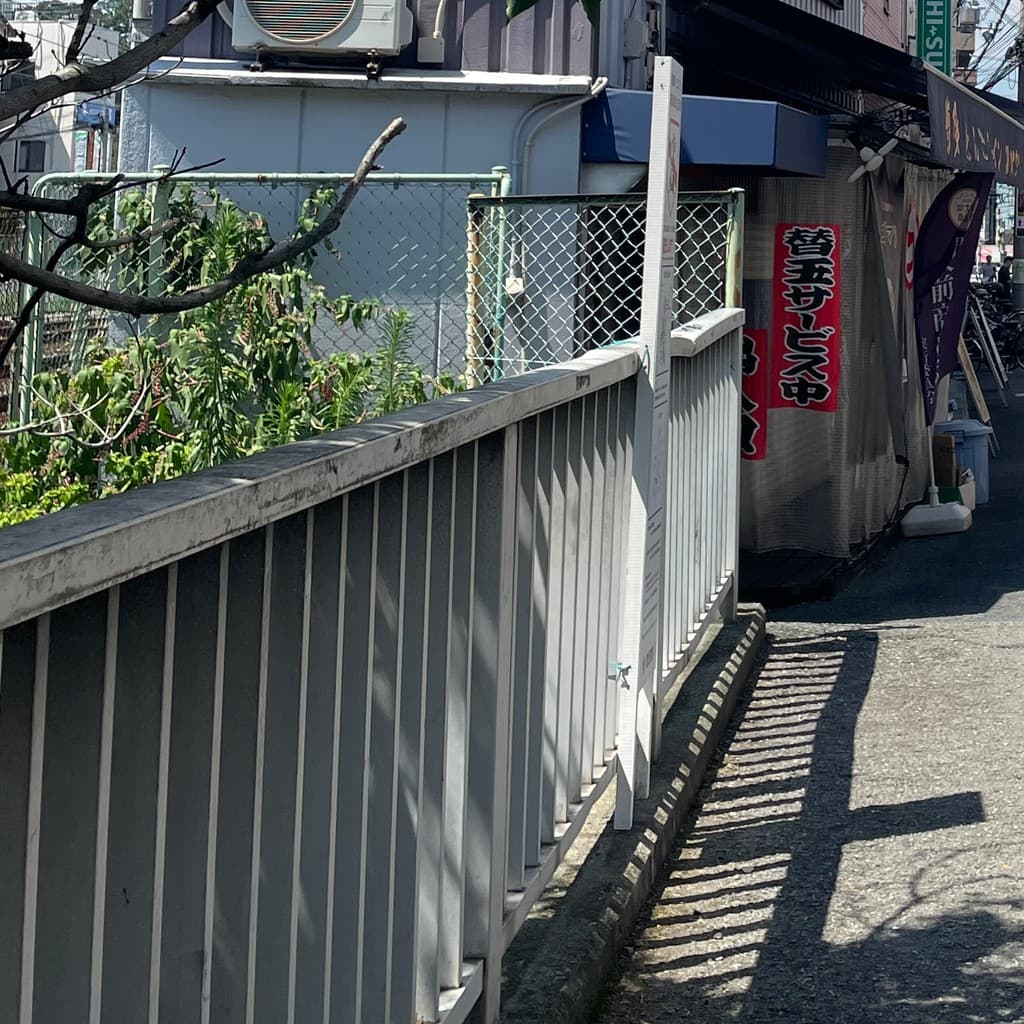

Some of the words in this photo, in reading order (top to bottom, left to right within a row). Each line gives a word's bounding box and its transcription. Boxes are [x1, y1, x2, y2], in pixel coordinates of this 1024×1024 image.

[779, 226, 836, 407] 替玉サービス中
